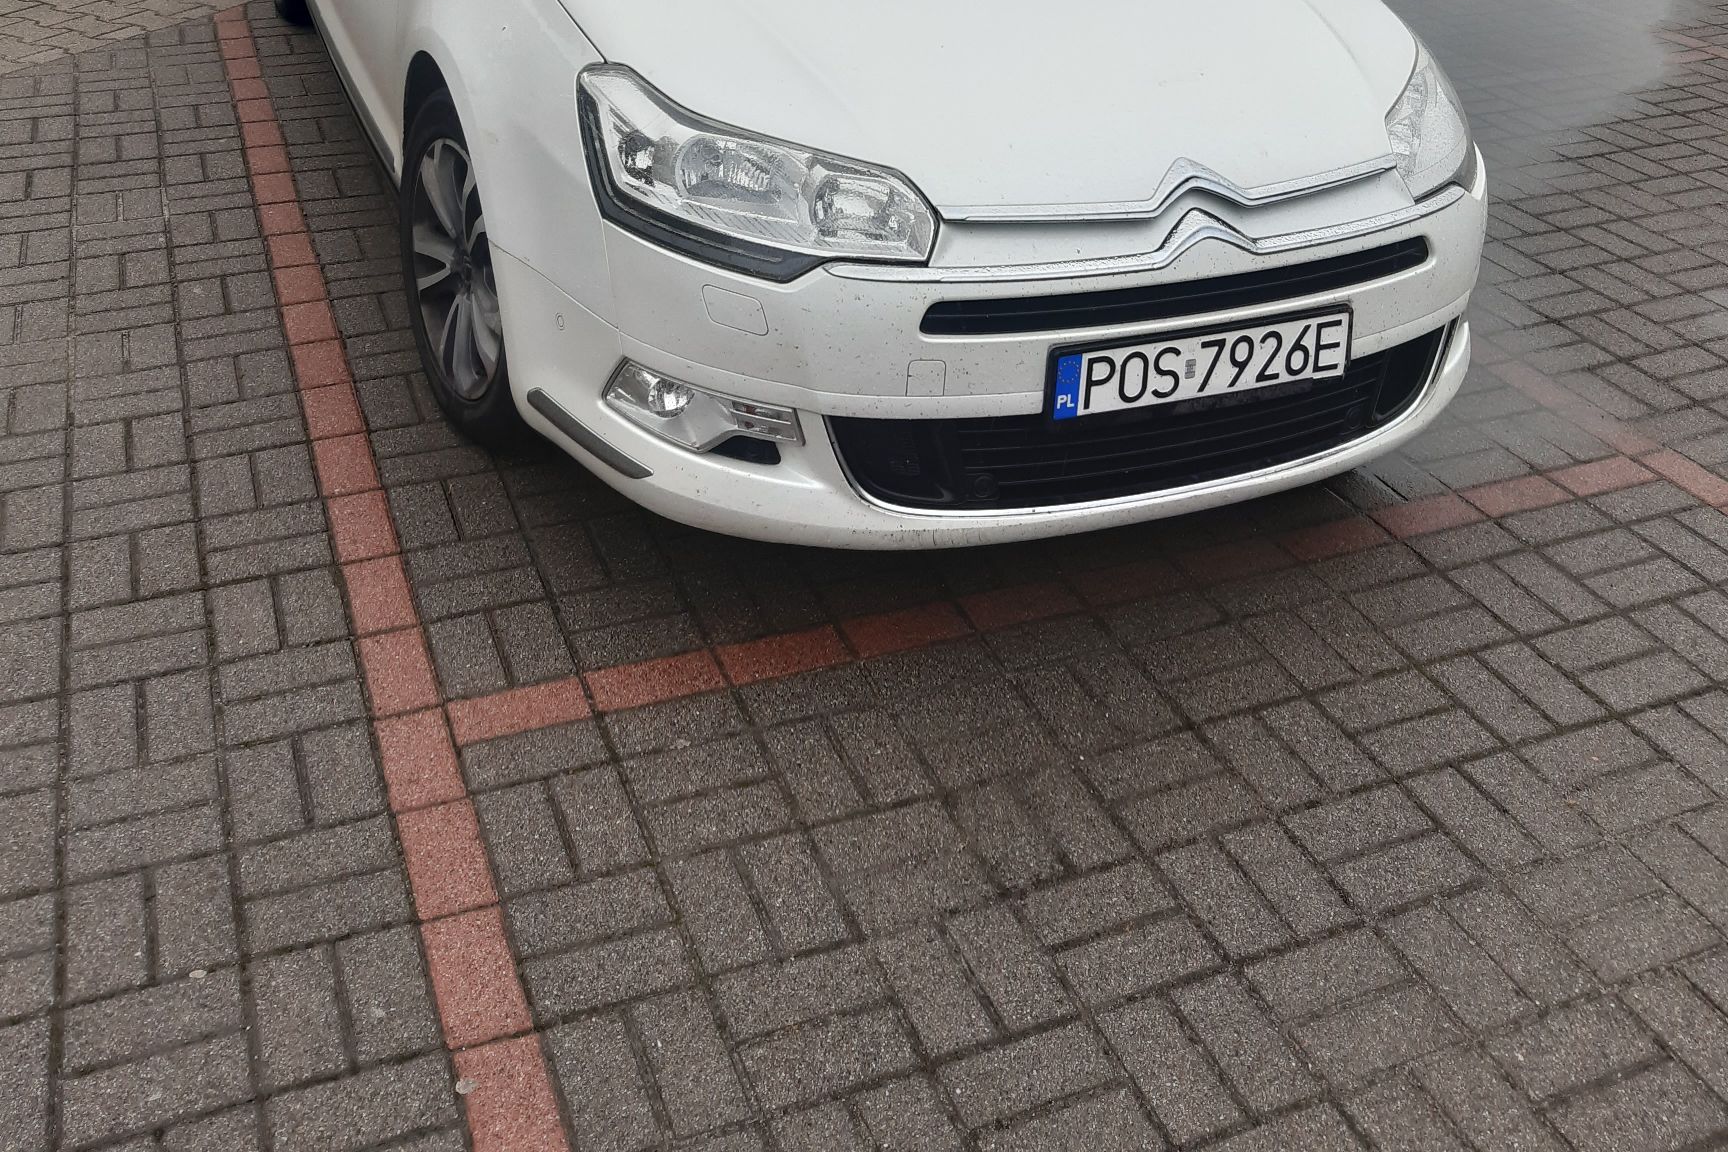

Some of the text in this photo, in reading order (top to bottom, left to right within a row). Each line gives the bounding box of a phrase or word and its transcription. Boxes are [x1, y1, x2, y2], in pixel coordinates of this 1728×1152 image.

[1083, 319, 1343, 410] POS 7926E
[1056, 394, 1075, 409] PL
